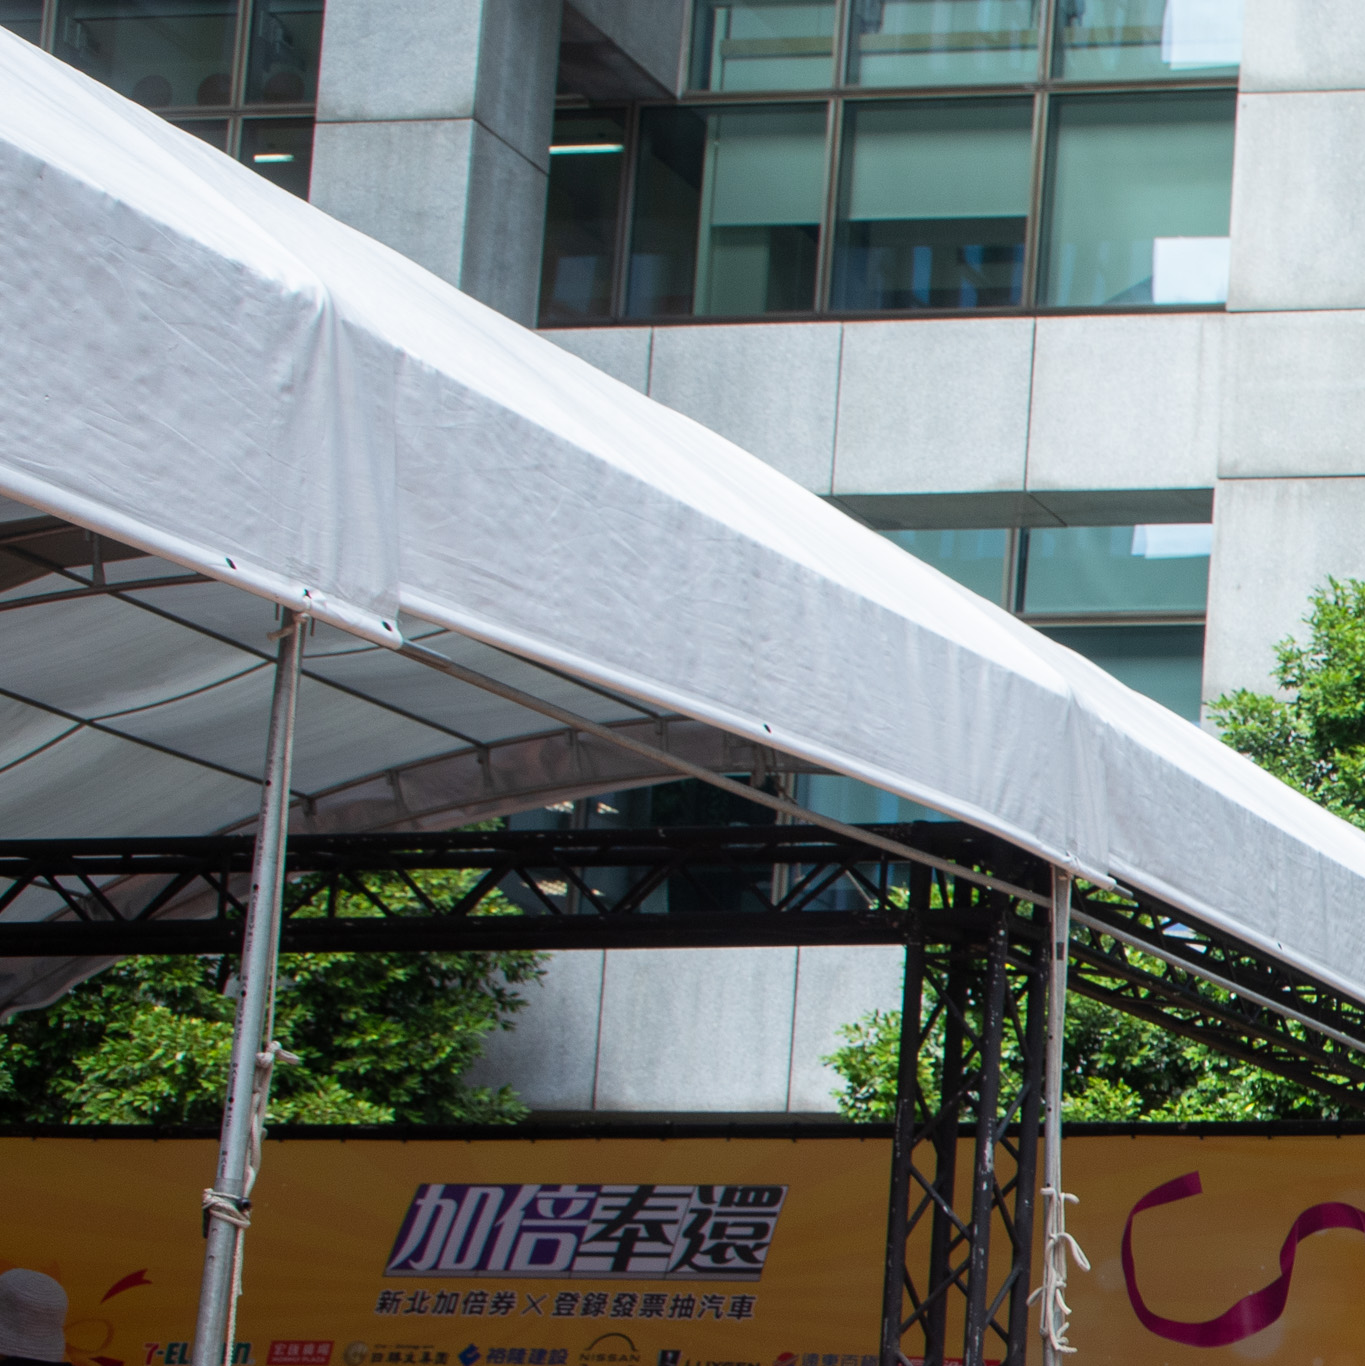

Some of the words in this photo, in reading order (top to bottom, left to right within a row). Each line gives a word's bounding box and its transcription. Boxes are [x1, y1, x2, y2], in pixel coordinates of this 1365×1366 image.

[386, 1184, 784, 1274] 加倍奉還
[375, 1289, 516, 1317] 新北加倍券
[551, 1290, 757, 1321] 登錄發票抽汽車
[579, 1353, 641, 1363] NISSAN
